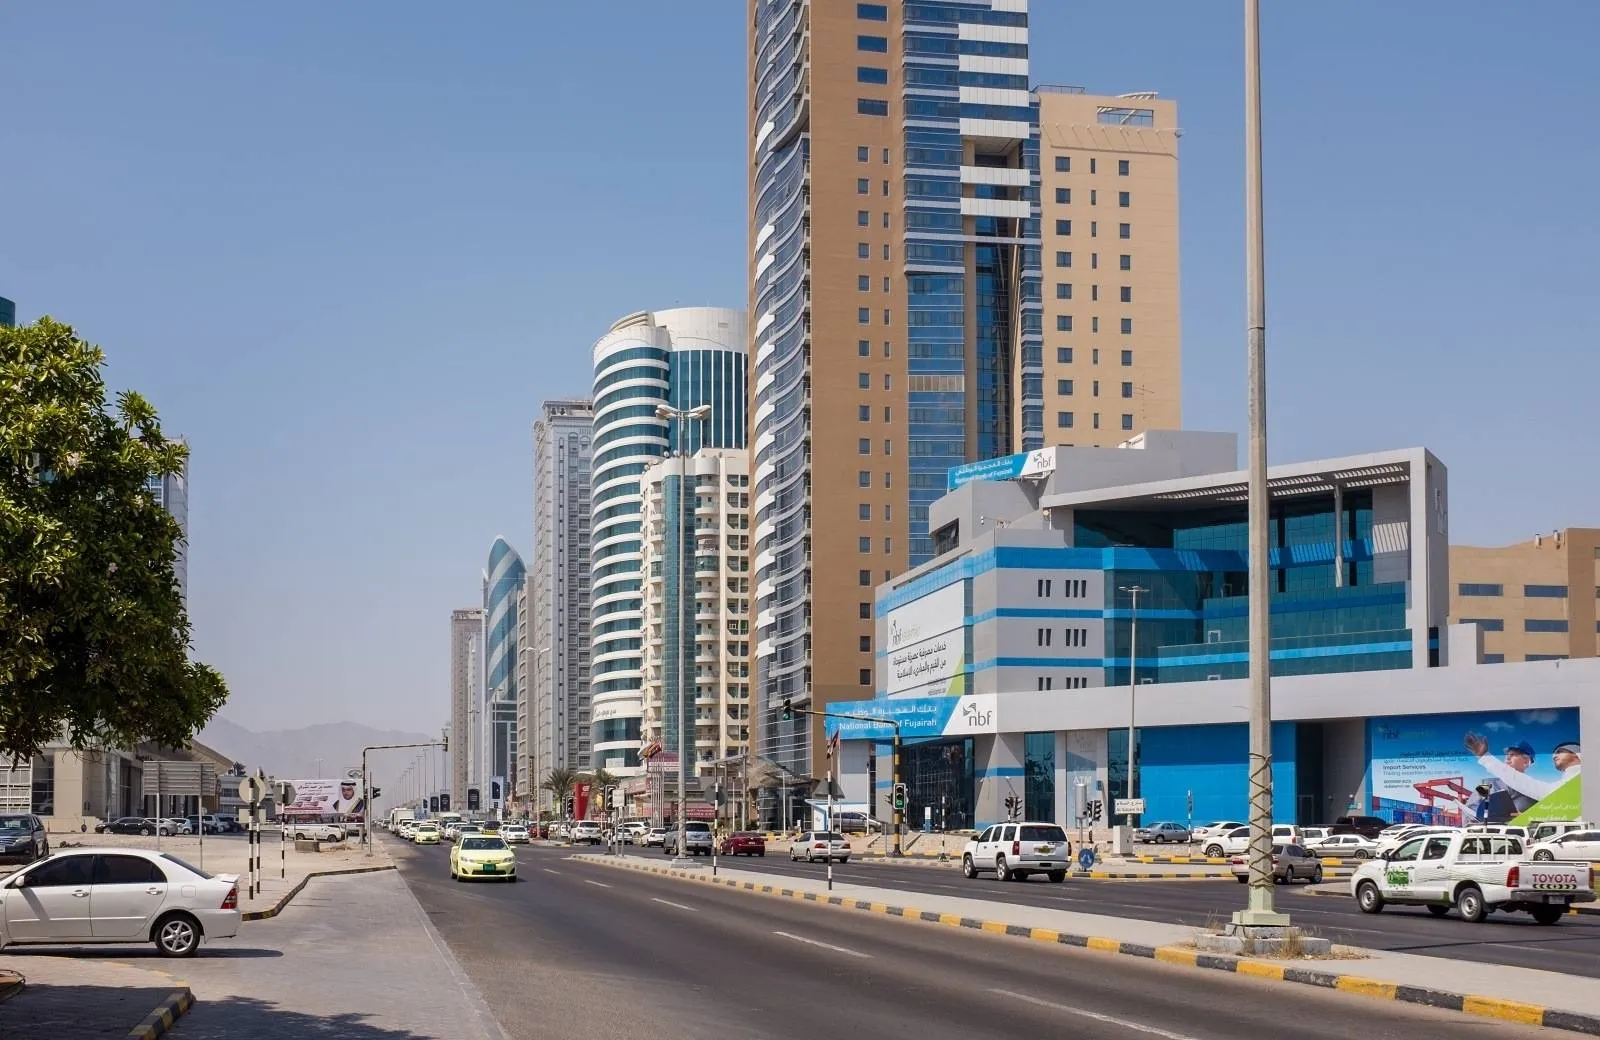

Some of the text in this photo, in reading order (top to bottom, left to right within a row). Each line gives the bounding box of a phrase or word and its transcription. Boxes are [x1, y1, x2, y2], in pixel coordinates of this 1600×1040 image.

[1037, 456, 1051, 469] nbf
[839, 721, 871, 730] National
[904, 718, 937, 728] Fujairah
[969, 710, 992, 727] nbf
[1532, 873, 1577, 883] TOYOTA
